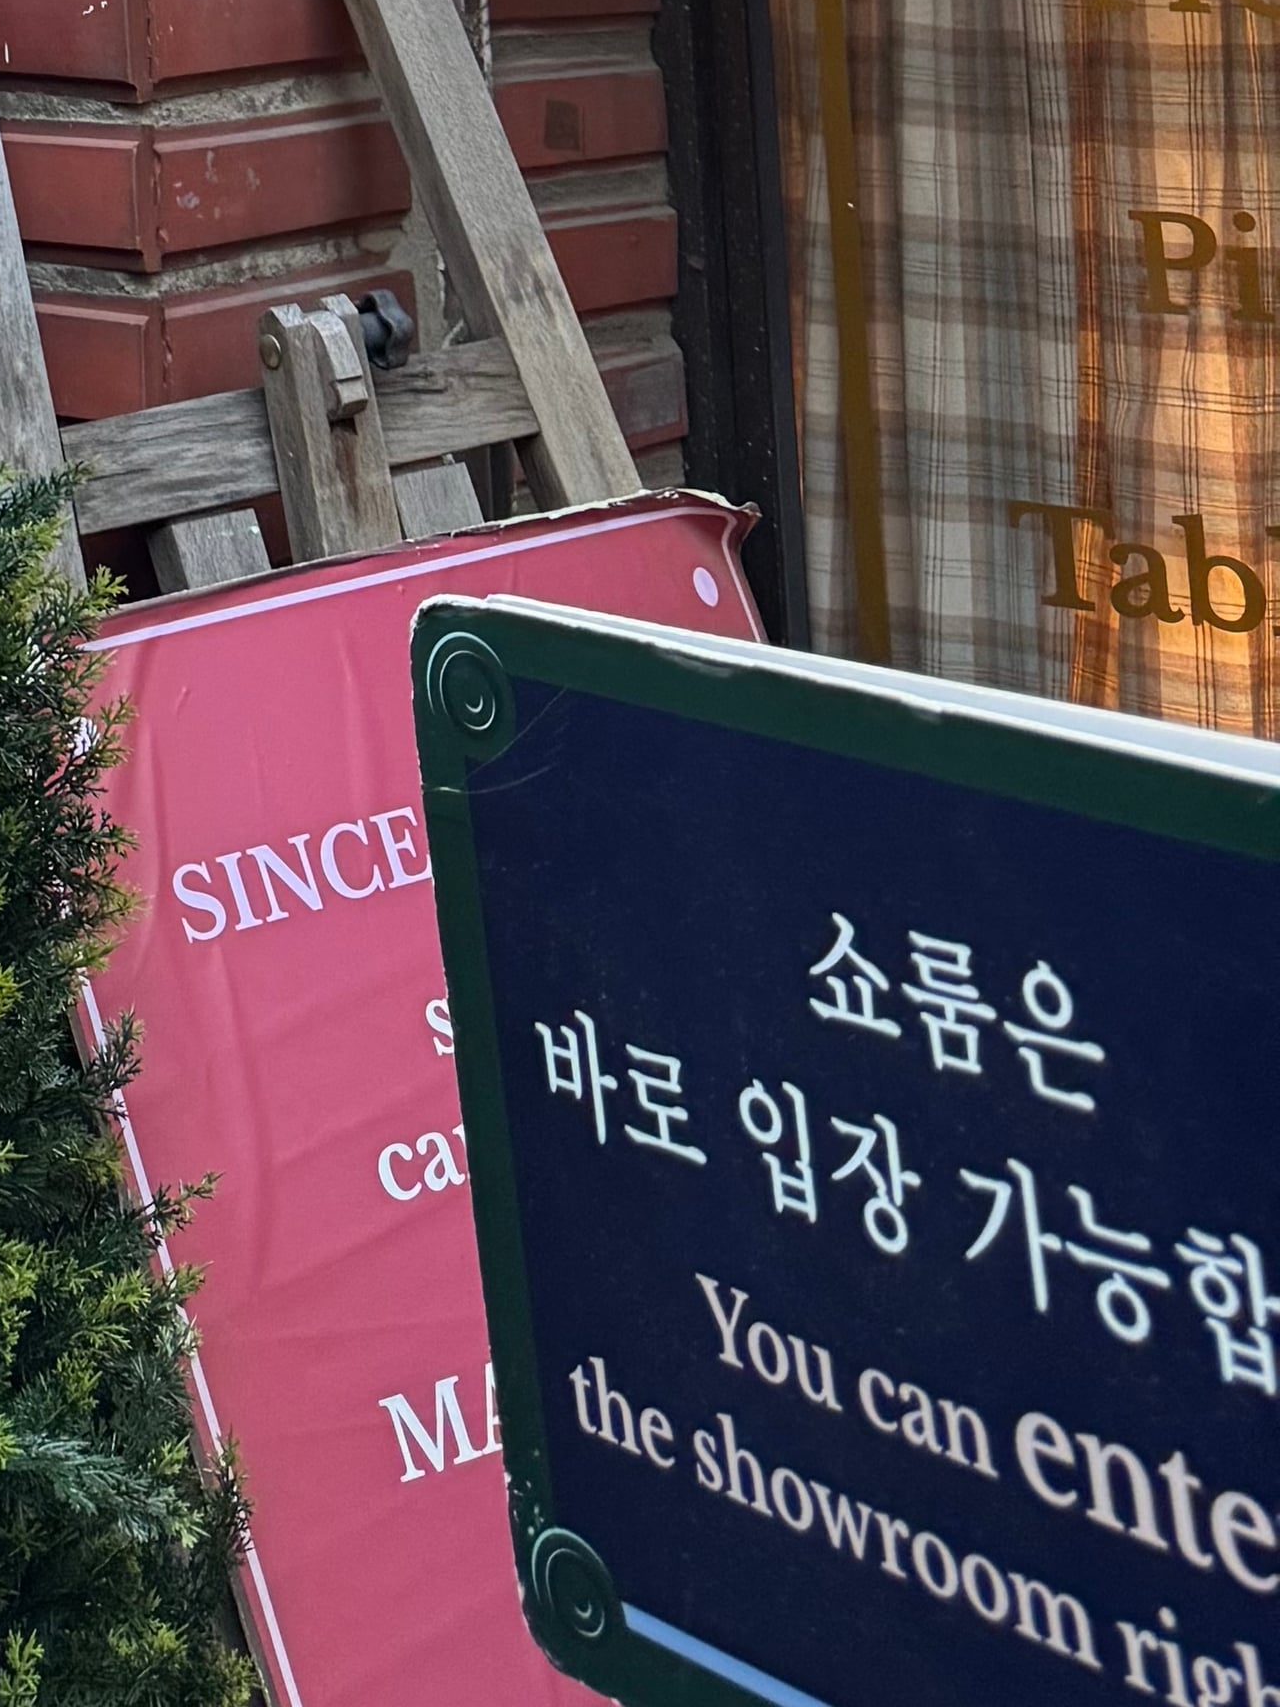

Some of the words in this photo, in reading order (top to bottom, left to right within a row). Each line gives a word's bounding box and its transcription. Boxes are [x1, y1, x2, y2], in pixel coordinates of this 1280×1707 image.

[1128, 210, 1276, 323] Pi
[1008, 499, 1280, 634] Tab
[171, 805, 433, 944] SINCE
[808, 911, 1106, 1113] 쇼룸은
[377, 1123, 471, 1201] ca
[533, 1008, 708, 1166] 바로
[738, 1077, 921, 1257] 입장
[695, 1273, 842, 1412] You
[858, 1364, 999, 1479] can
[569, 1354, 676, 1469] the
[695, 1410, 1103, 1672] showroom
